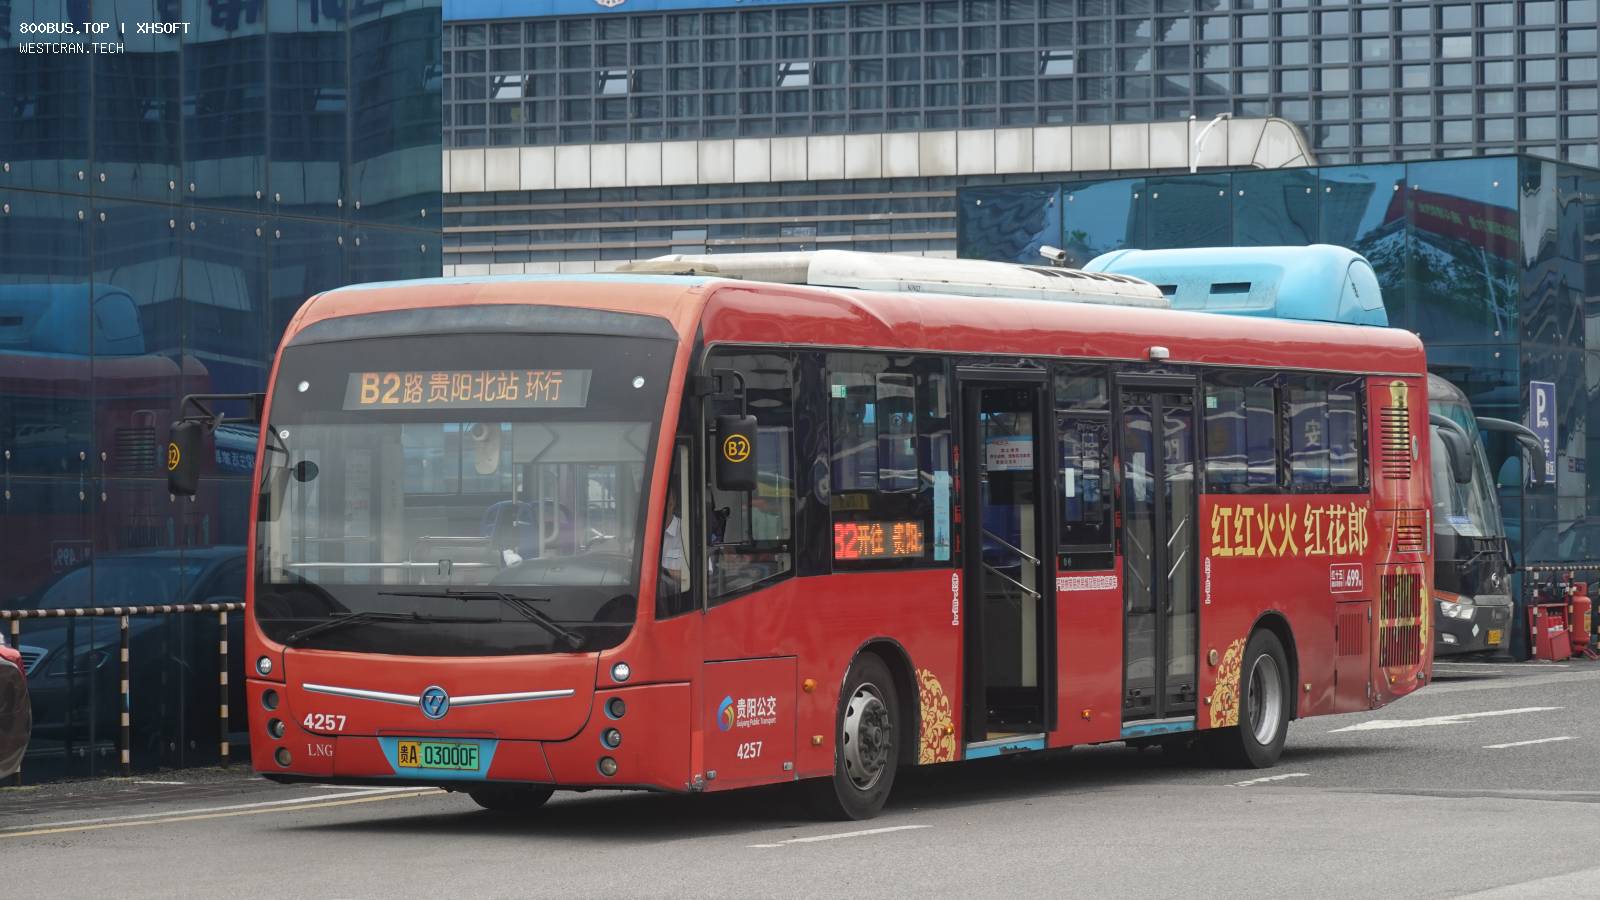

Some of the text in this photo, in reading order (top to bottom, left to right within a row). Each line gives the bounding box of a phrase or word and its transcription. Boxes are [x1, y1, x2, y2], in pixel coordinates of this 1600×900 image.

[360, 370, 563, 404] B2路 贵阳北站 环行
[1536, 388, 1546, 428] P
[728, 441, 747, 456] B2
[1211, 502, 1369, 557] 红红火火 红花郎
[737, 696, 776, 719] 贵阳公交
[303, 713, 347, 731] 4257
[307, 744, 333, 756] LNG
[400, 745, 477, 766] 贵A 03000F
[737, 741, 762, 759] 4257
